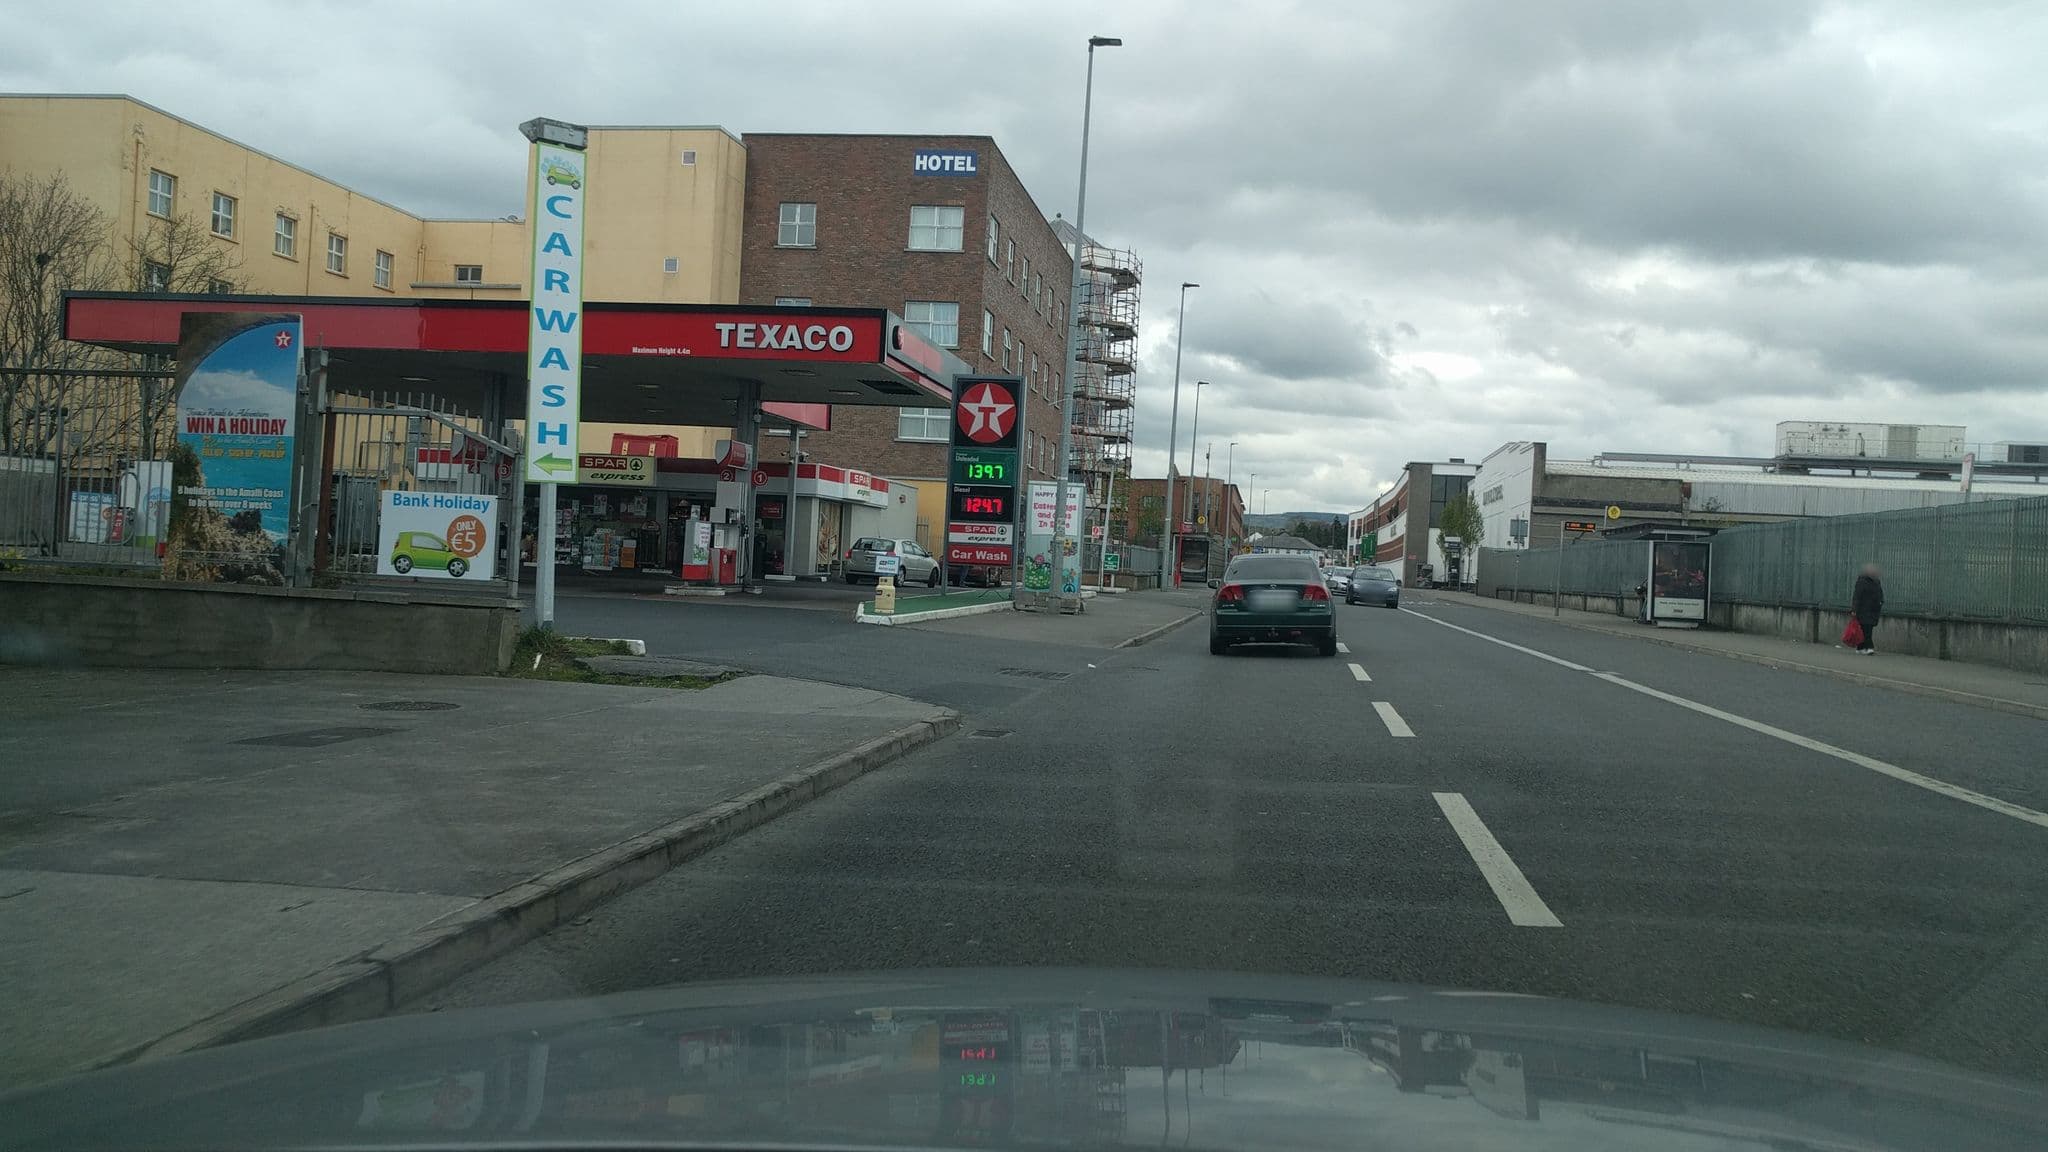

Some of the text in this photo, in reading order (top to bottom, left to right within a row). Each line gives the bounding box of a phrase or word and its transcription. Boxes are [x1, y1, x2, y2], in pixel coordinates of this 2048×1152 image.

[915, 155, 976, 171] HOTEL
[715, 323, 853, 351] TEXACO
[658, 347, 676, 355] Height
[187, 417, 287, 435] WIN A HOLIDAY
[585, 457, 626, 469] SPAR
[591, 471, 647, 481] express
[184, 486, 216, 498] holidays
[217, 488, 225, 497] to
[226, 487, 238, 498] the
[263, 489, 284, 499] Coast
[188, 499, 197, 508] to
[198, 499, 207, 508] be
[225, 500, 241, 509] over
[249, 501, 273, 510] weeks
[393, 493, 490, 513] Bank Holiday
[456, 519, 477, 532] ONLY
[965, 525, 996, 533] SPAR
[451, 532, 477, 553] €5
[952, 549, 1008, 561] Car Wash
